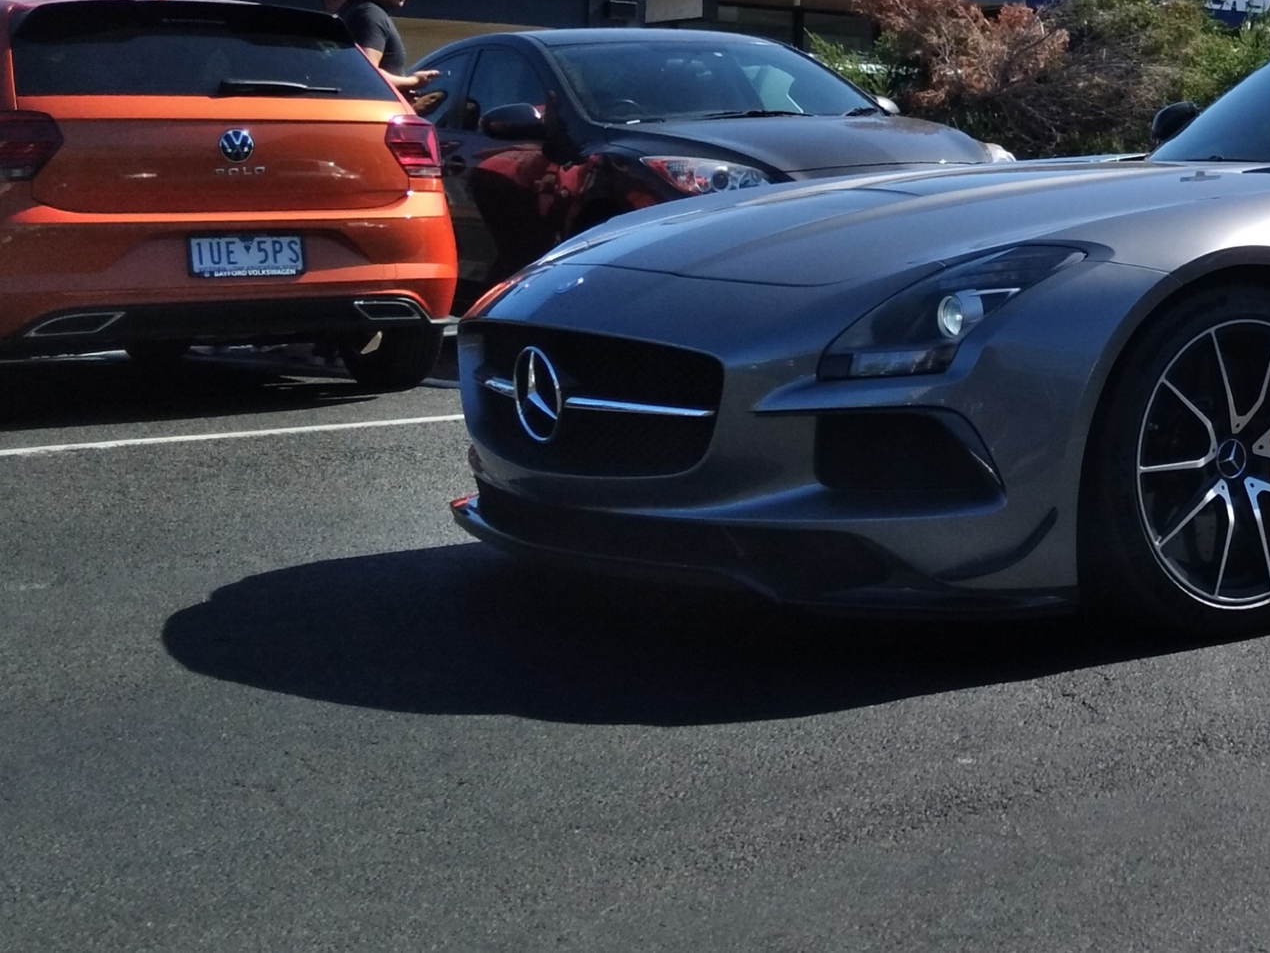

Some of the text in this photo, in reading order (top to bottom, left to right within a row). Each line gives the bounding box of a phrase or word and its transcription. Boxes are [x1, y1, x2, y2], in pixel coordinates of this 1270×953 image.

[215, 166, 266, 176] POLO
[196, 240, 300, 265] 1UE 5PS
[248, 268, 296, 277] VOLKSWAGEN
